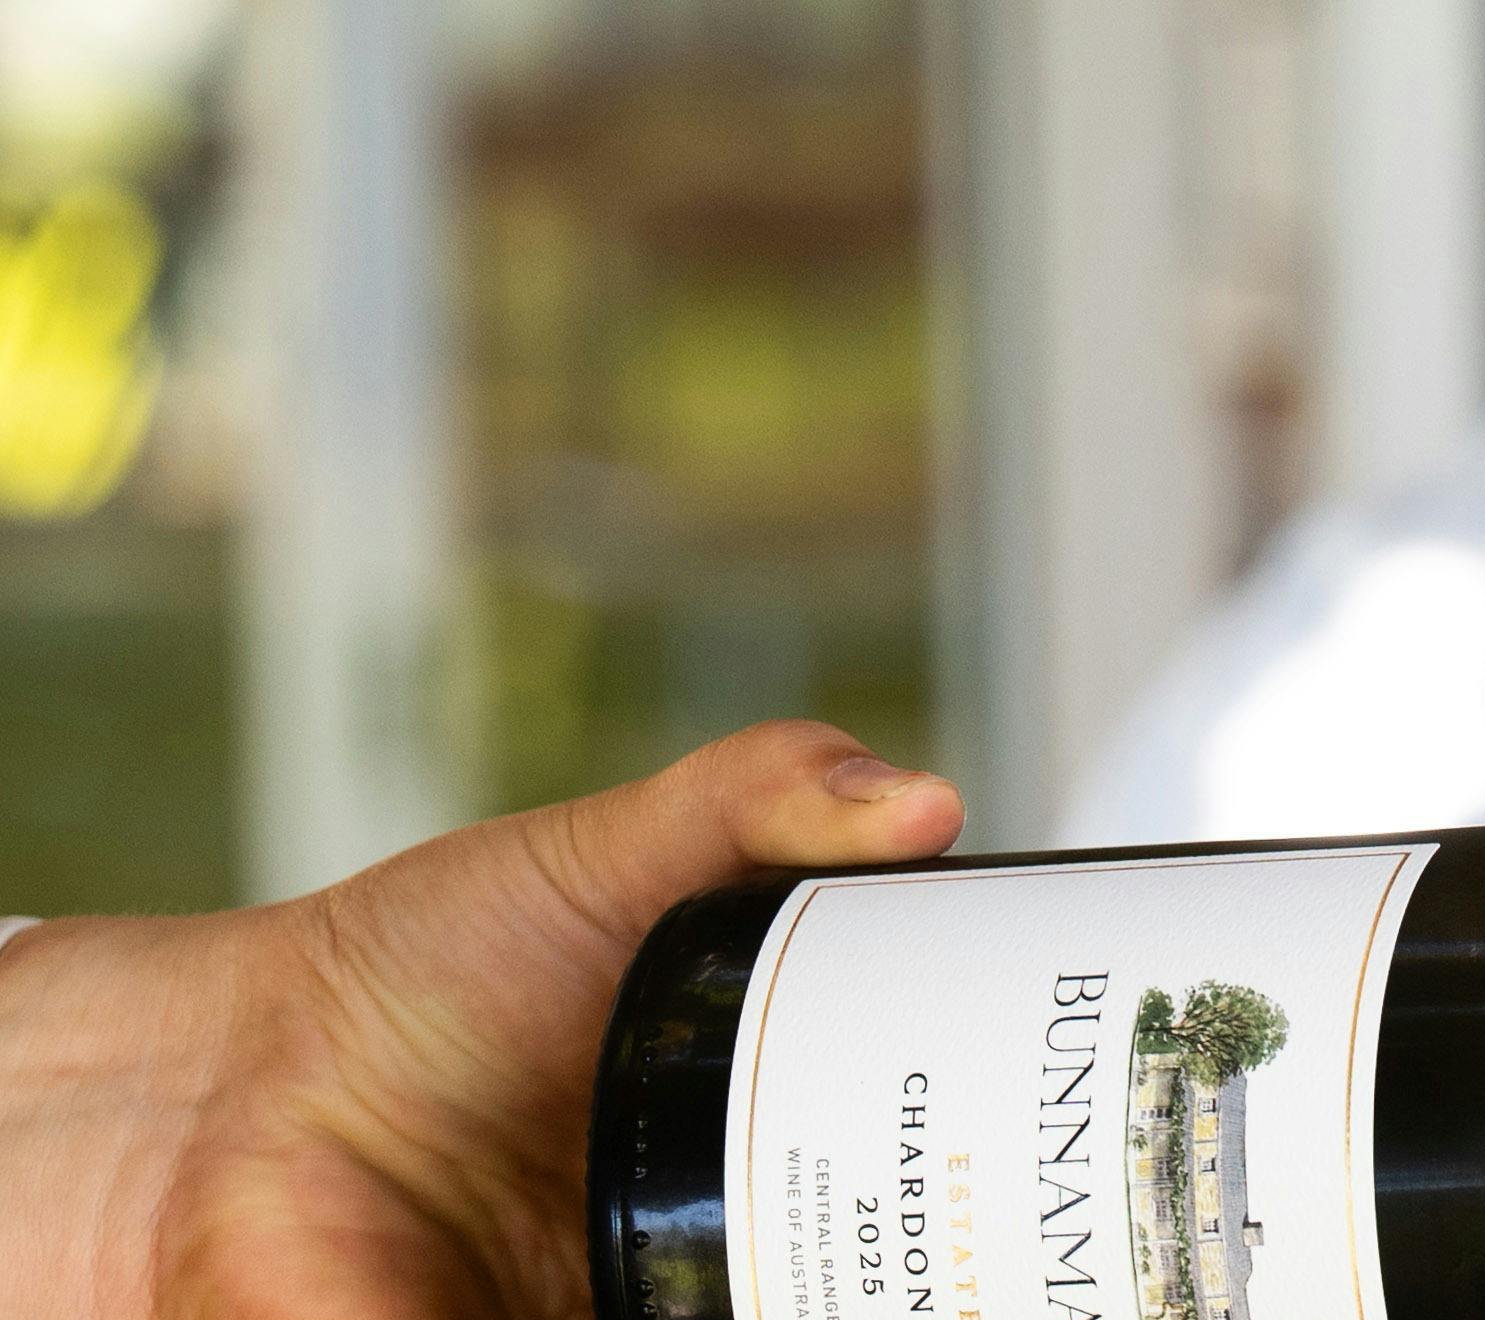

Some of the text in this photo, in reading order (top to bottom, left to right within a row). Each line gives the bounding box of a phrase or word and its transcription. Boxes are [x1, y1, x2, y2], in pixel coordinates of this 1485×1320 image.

[786, 1147, 802, 1199] WINE
[815, 1158, 833, 1251] CENTRAL
[787, 1207, 803, 1232] OF
[855, 1197, 885, 1296] 2025
